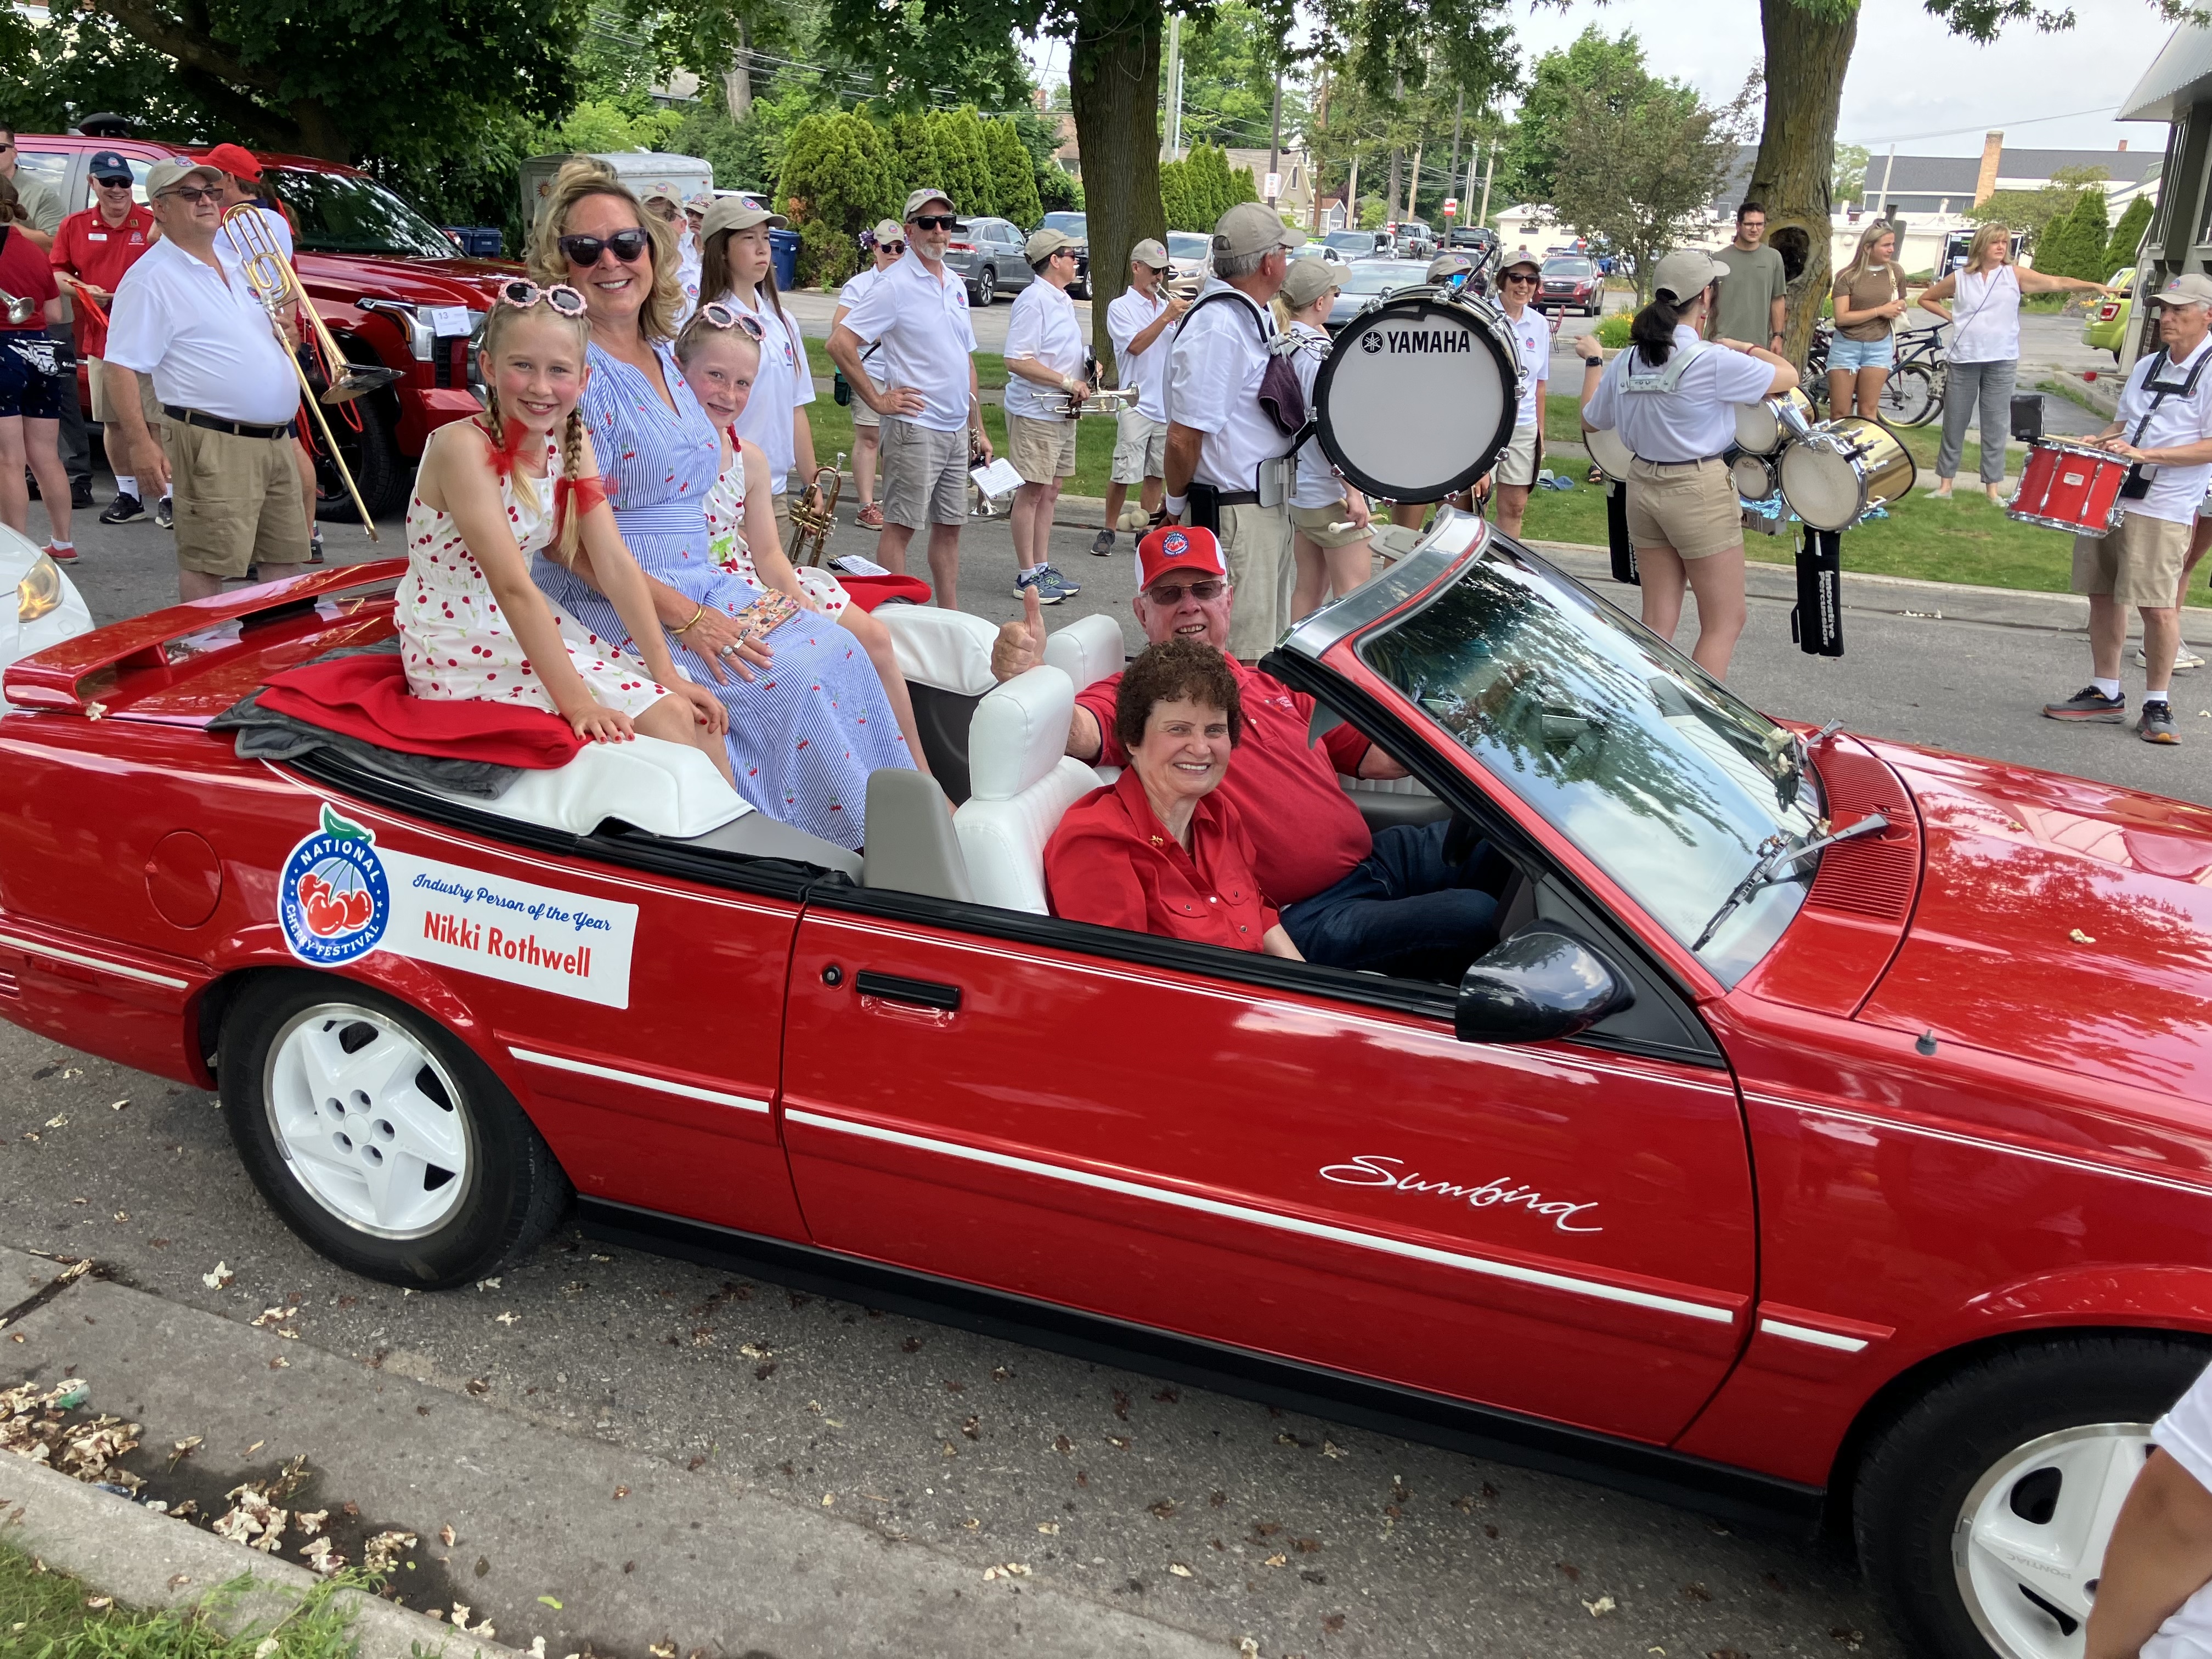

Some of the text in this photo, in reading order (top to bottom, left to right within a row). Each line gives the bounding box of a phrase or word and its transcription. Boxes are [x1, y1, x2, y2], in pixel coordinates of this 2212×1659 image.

[438, 312, 449, 320] 13
[1387, 331, 1470, 353] YAMAHA
[1818, 571, 1829, 647] Percussion
[1825, 570, 1835, 639] Innovative
[300, 839, 380, 883] NATIONAL
[286, 904, 380, 957] CHERRY FESTIVAL
[413, 873, 612, 932] Industry Person of the Year
[424, 911, 591, 978] Nikki Rothwell
[1319, 1155, 1603, 1232] Sunbird
[2006, 1553, 2072, 1579] PONTIAC
